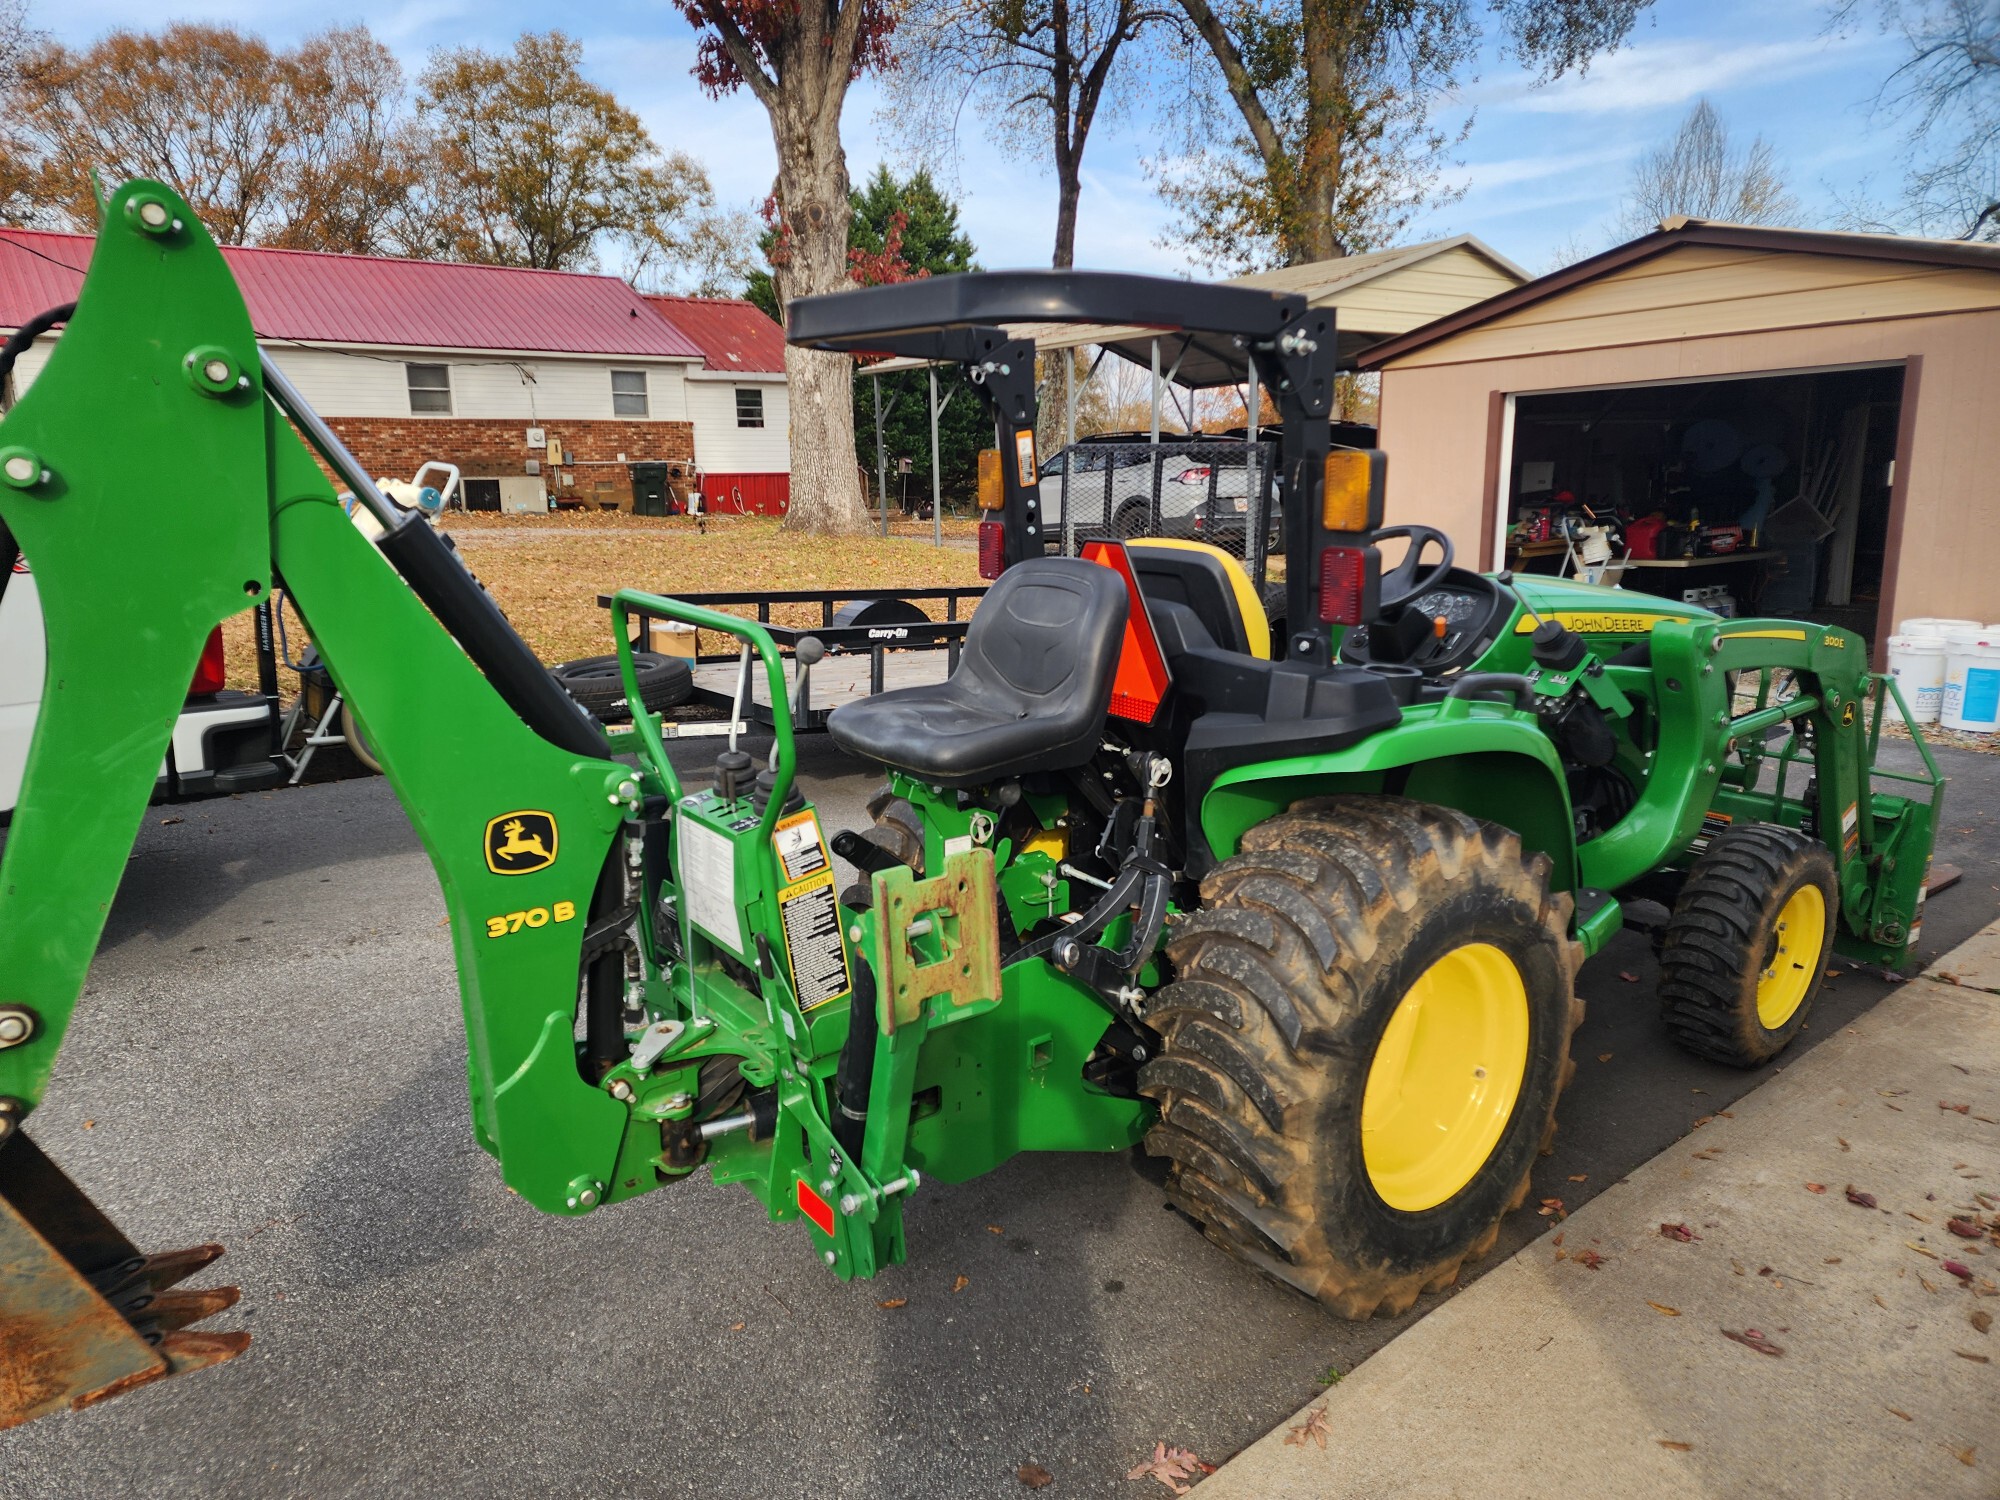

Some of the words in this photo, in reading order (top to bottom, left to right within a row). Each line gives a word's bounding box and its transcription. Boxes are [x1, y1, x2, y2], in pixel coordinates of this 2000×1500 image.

[1568, 616, 1603, 631] JOHN
[1604, 616, 1645, 631] DEERE
[868, 628, 908, 639] Carry-On
[1824, 635, 1845, 649] 300E
[793, 876, 827, 896] CAUTION
[486, 907, 550, 938] 370
[552, 900, 576, 923] B
